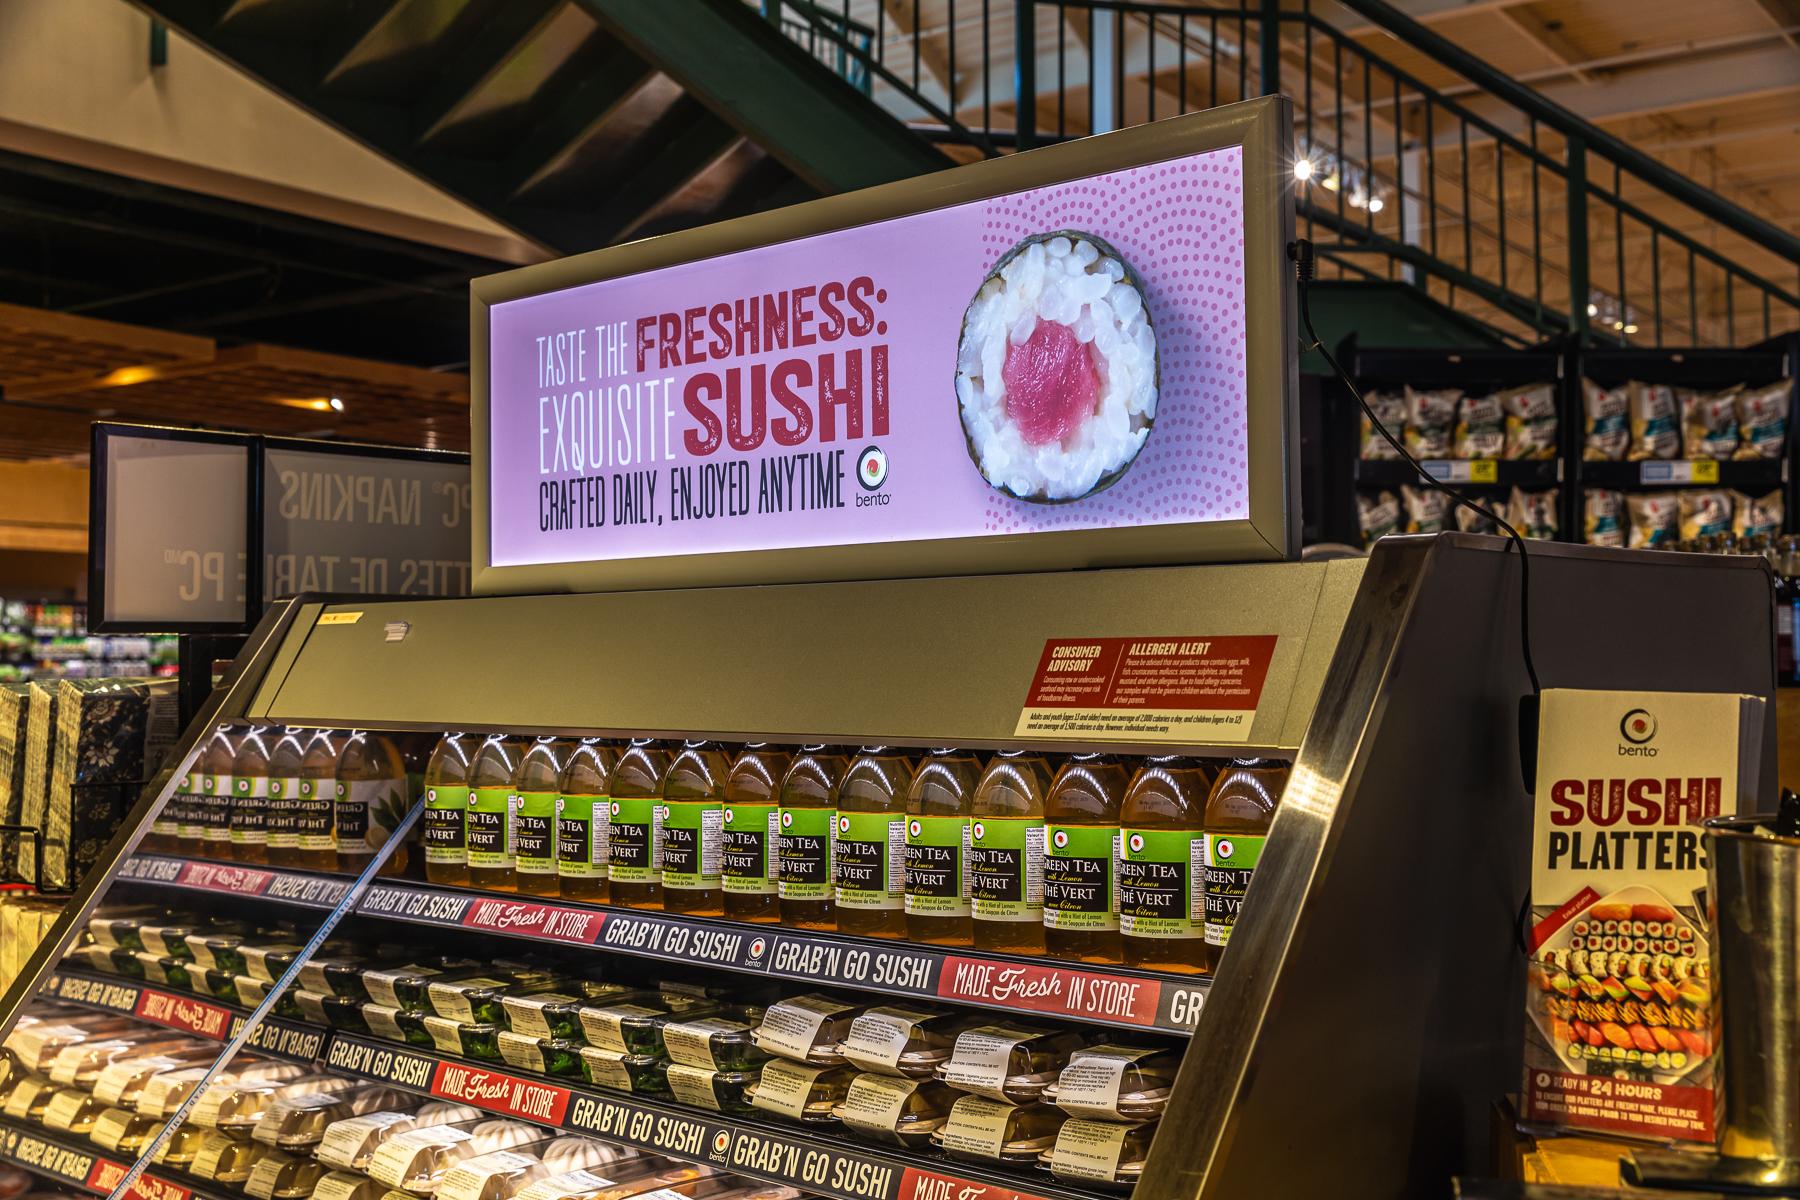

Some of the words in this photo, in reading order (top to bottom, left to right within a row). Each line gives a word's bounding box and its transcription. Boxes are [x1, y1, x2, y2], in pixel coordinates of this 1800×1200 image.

[536, 329, 586, 388] TASTE
[596, 320, 628, 377] THE
[635, 275, 888, 373] FRESHNESS:
[539, 377, 676, 476] EXQUISITE
[683, 344, 890, 457] SUSHI
[539, 476, 605, 532] CRAFTED
[613, 469, 662, 527] DAILY,
[671, 460, 750, 521] ENJOYED
[758, 449, 845, 514] ANYTIME
[855, 491, 891, 507] bento
[1052, 645, 1101, 658] CONSUMER
[1128, 643, 1178, 656] ALLERGEN
[1178, 642, 1211, 655] ALERT
[1047, 659, 1093, 672] ADVISORY
[1618, 743, 1658, 757] bento
[1550, 777, 1722, 826] SUSHI
[853, 843, 877, 855] TEA
[925, 848, 950, 860] TEA
[989, 850, 1014, 863] TEA
[843, 866, 872, 879] VERT
[1073, 859, 1101, 873] TEA
[1149, 864, 1178, 878] TEA
[914, 872, 946, 885] VERT
[979, 876, 1008, 889] VERT
[1058, 872, 1083, 882] Lemon
[1134, 877, 1160, 887] Lemon
[1060, 886, 1095, 900] VERT
[1136, 891, 1173, 906] VERT
[363, 889, 412, 913] GRAB'N
[406, 894, 429, 915] GO
[424, 896, 468, 921] SUSHI
[1059, 899, 1082, 910] Citron
[1135, 905, 1159, 917] Citron
[473, 901, 506, 926] MADE
[498, 904, 545, 928] Fresh
[542, 910, 561, 934] IN
[555, 912, 594, 939] STORE
[605, 918, 665, 950] GRAB'N
[664, 926, 689, 954] GO
[689, 930, 742, 962] SUSHI
[744, 958, 762, 968] bento
[775, 941, 841, 977] GRAB'N
[843, 950, 870, 981] GO
[873, 953, 932, 989] SUSHI
[953, 963, 996, 998] MADE
[992, 967, 1062, 1001] Fresh
[1066, 976, 1086, 1010] IN
[1086, 978, 1140, 1018] STORE
[329, 1040, 375, 1073] GRAB'N
[372, 1051, 393, 1078] GO
[391, 1055, 432, 1087] SUSHI
[440, 1066, 470, 1097] MADE
[465, 1073, 509, 1100] Fresh
[510, 1082, 525, 1111] IN
[522, 1086, 558, 1119] STORE
[1553, 1076, 1578, 1090] READY
[1579, 1079, 1588, 1091] IN
[1591, 1079, 1612, 1096] 24
[1615, 1083, 1662, 1101] HOURS
[1577, 1095, 1603, 1107] PLATTERS
[571, 1097, 630, 1137] GRAB'N
[629, 1111, 654, 1142] GO
[653, 1116, 706, 1155] SUSHI
[708, 1152, 726, 1163] bento
[733, 1134, 802, 1178] GRAB'N
[802, 1149, 830, 1185] GO
[831, 1157, 892, 1200] SUSHI
